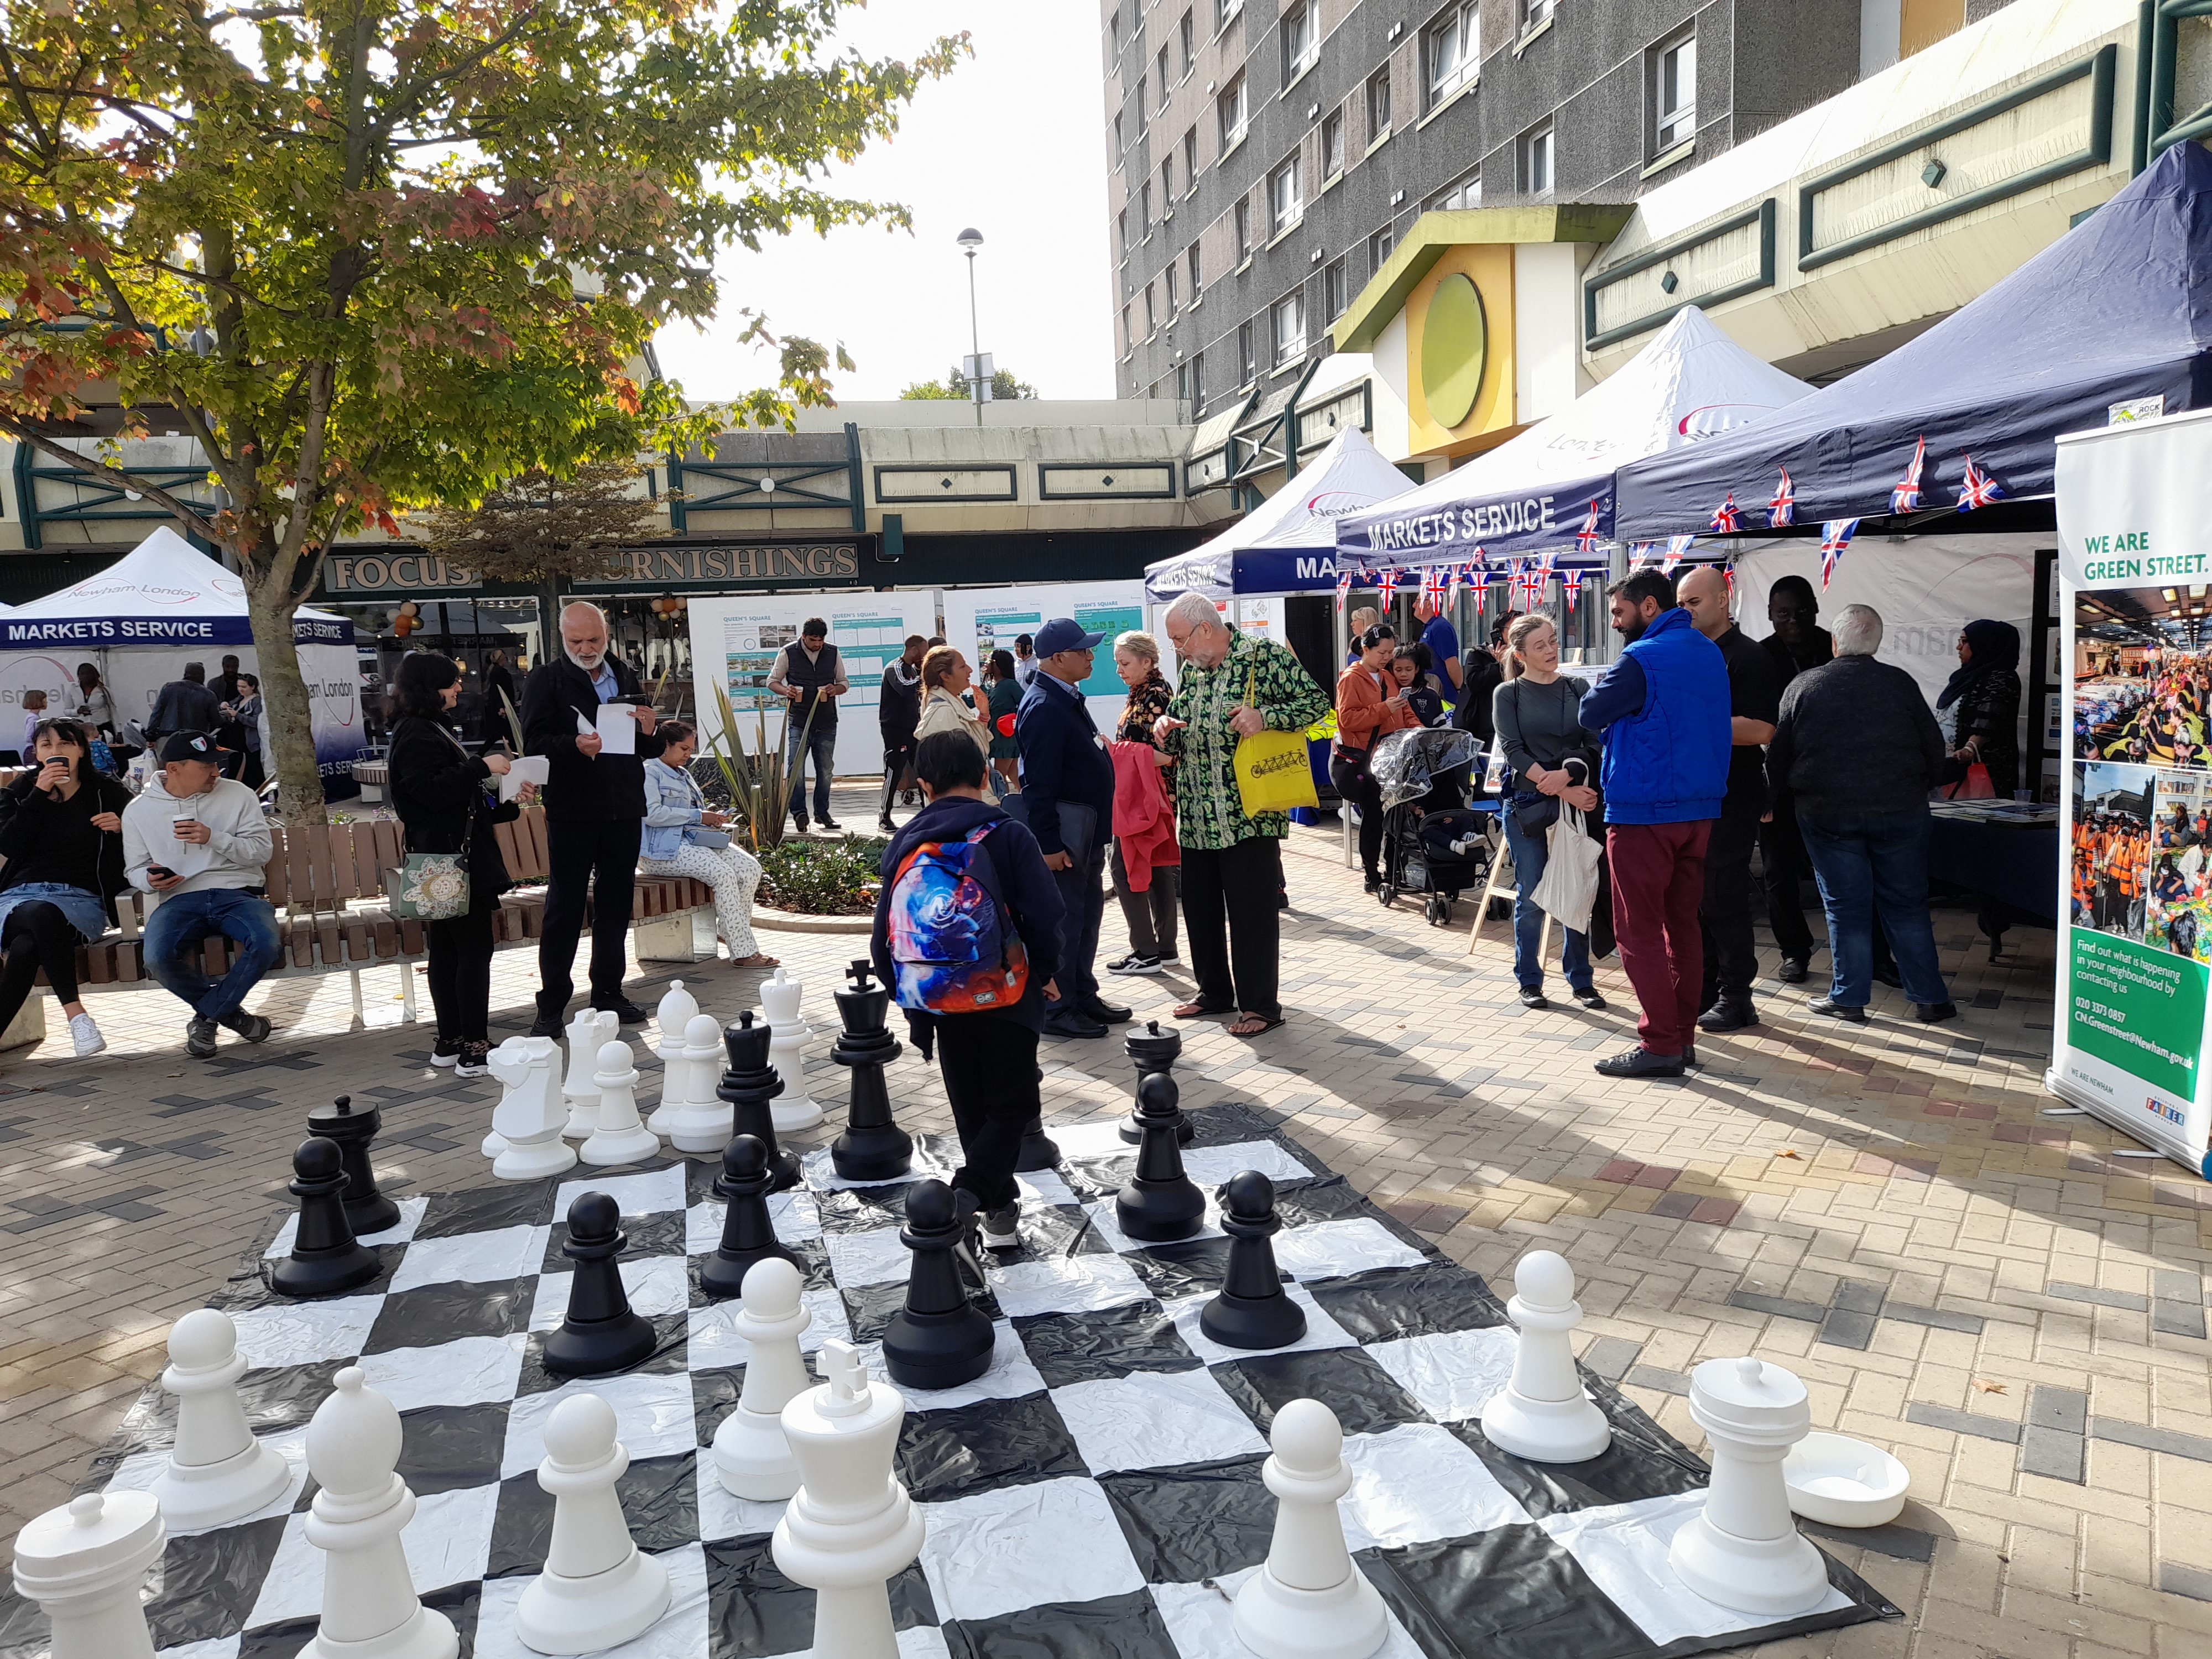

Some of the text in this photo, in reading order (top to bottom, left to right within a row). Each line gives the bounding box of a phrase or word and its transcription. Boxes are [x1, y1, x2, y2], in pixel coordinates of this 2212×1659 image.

[2138, 403, 2161, 414] ROCK
[1308, 504, 1375, 518] Newh
[1367, 496, 1557, 551] MARKETS SERVICE
[2084, 531, 2150, 554] WE ARE
[332, 556, 473, 589] FOCUS
[1154, 564, 1218, 592] MARKETS SERVICE
[2084, 554, 2209, 581] GREEN STREET.
[67, 584, 201, 598] Newham London
[9, 621, 214, 640] MARKETS SERVICE
[312, 623, 342, 639] SERVICE
[2122, 649, 2144, 658] EYEBRO
[322, 677, 354, 698] London
[2077, 939, 2182, 984] Find out what is happening
[2077, 953, 2176, 998] in your neighbourhood by
[2077, 970, 2128, 994] contacting us
[2075, 996, 2126, 1023] 020 3373 0857
[2074, 1010, 2194, 1070] CN.Greenstreet@Newham.gov.uk
[2071, 1067, 2115, 1096] WE ARE NEWHAM.
[2146, 1098, 2184, 1126] FAIRER
